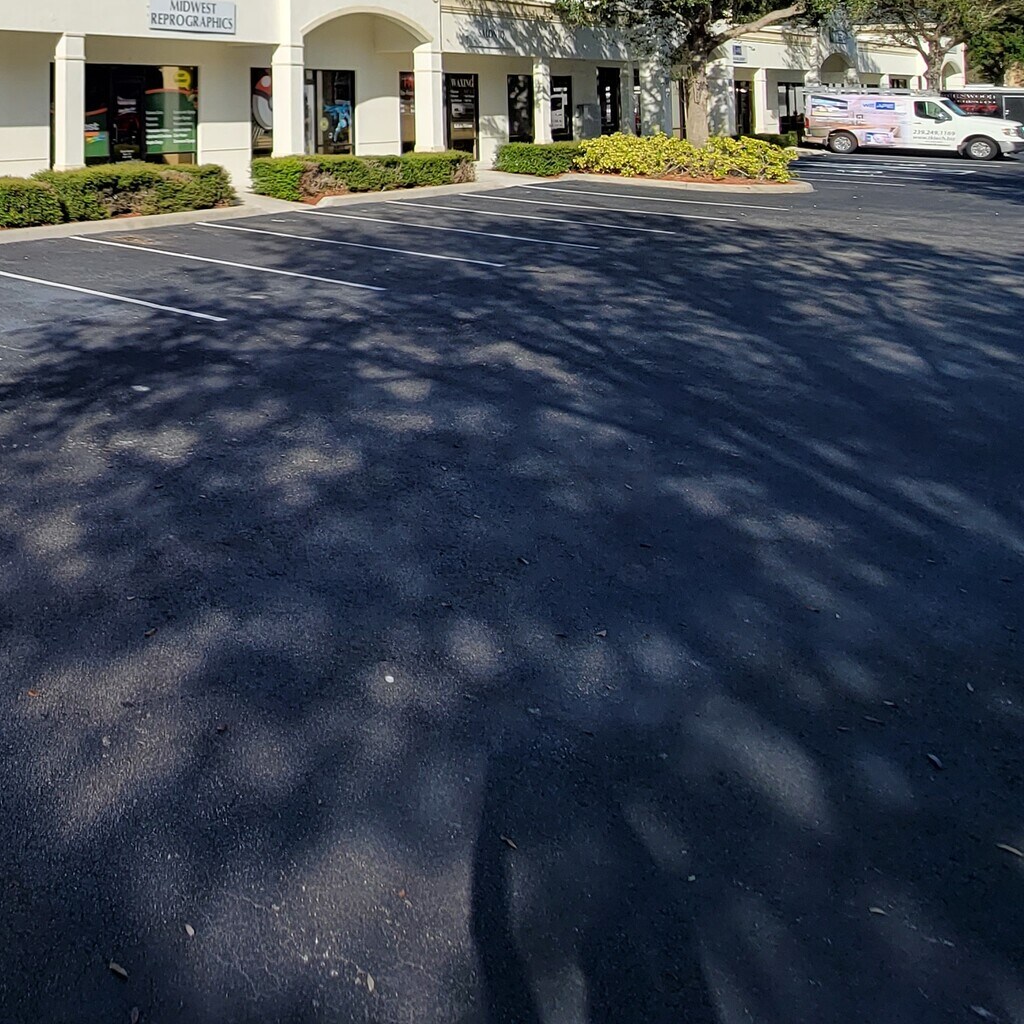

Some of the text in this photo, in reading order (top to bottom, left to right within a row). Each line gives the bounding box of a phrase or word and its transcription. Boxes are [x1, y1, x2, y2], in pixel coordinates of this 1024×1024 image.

[170, 0, 216, 14] MIDWEST
[151, 13, 232, 29] REPROGRAPHICS
[451, 78, 474, 88] WAXING
